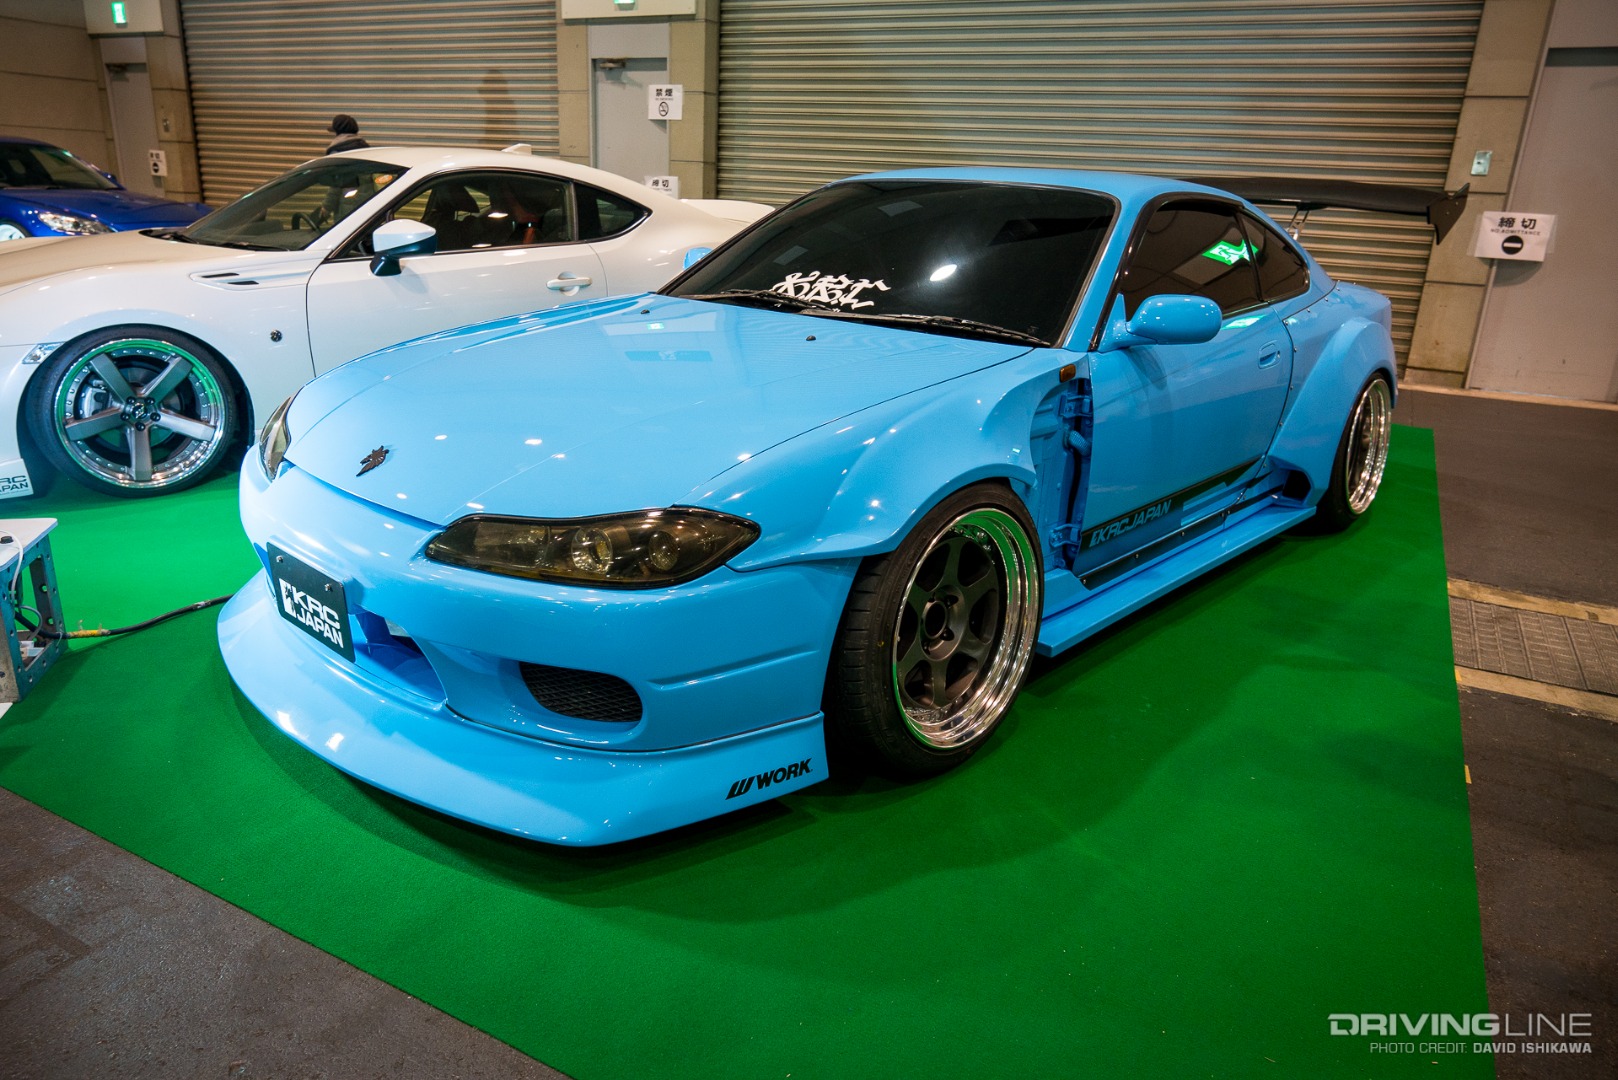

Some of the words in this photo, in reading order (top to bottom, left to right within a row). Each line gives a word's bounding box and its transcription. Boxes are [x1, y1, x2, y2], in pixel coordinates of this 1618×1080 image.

[1498, 217, 1537, 230] 締切
[0, 475, 27, 484] RC
[0, 482, 29, 492] PAN
[291, 585, 341, 630] KRC
[296, 607, 344, 649] JAPAN
[756, 757, 813, 790] WORK
